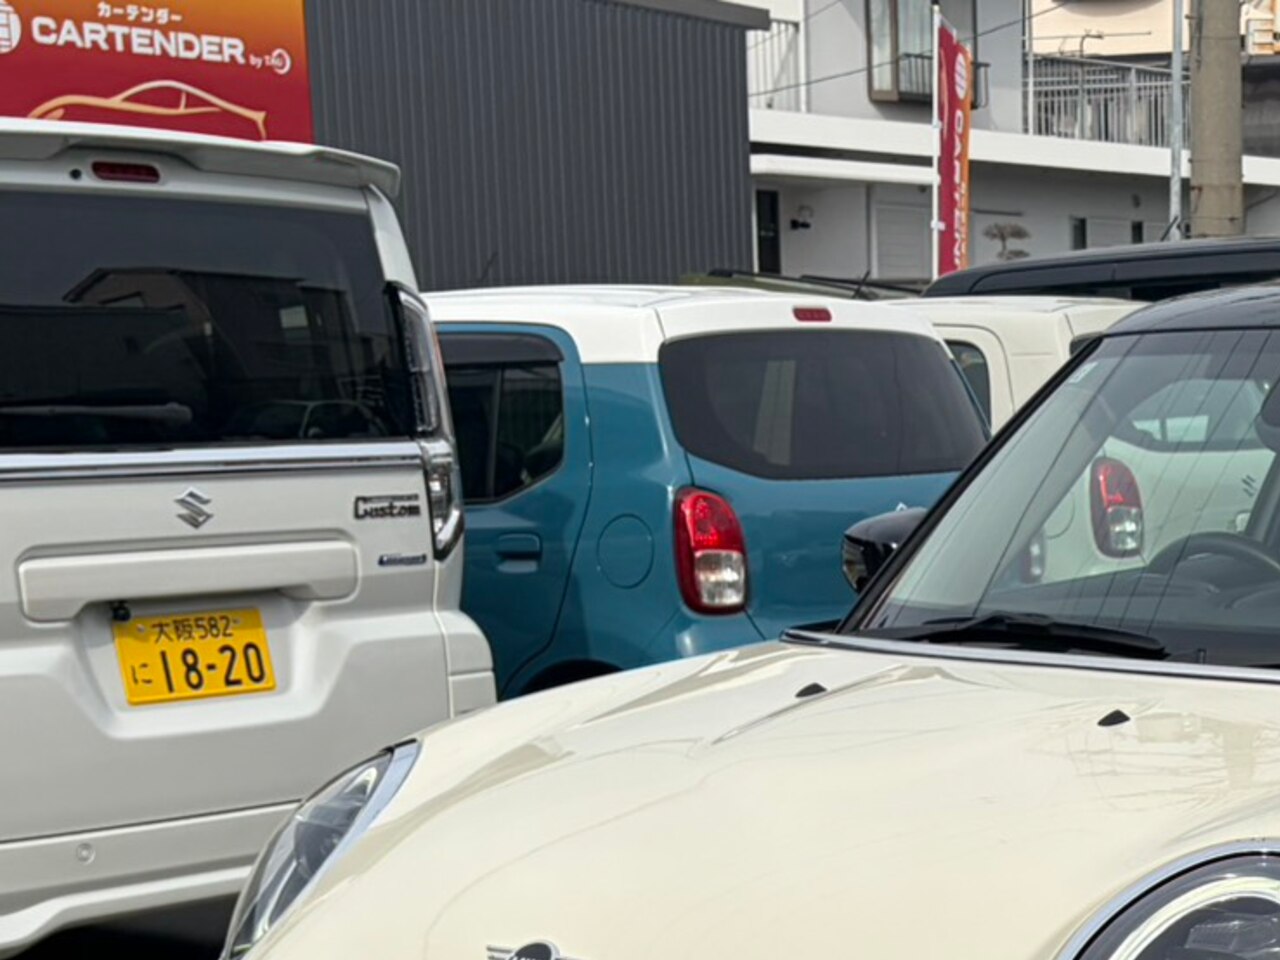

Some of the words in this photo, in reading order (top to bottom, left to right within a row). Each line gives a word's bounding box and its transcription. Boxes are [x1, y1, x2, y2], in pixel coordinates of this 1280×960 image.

[98, 3, 182, 24] カーテンダー
[31, 16, 245, 64] CARTENDER
[249, 53, 262, 69] by
[131, 663, 153, 685] に
[161, 642, 266, 693] 18-20
